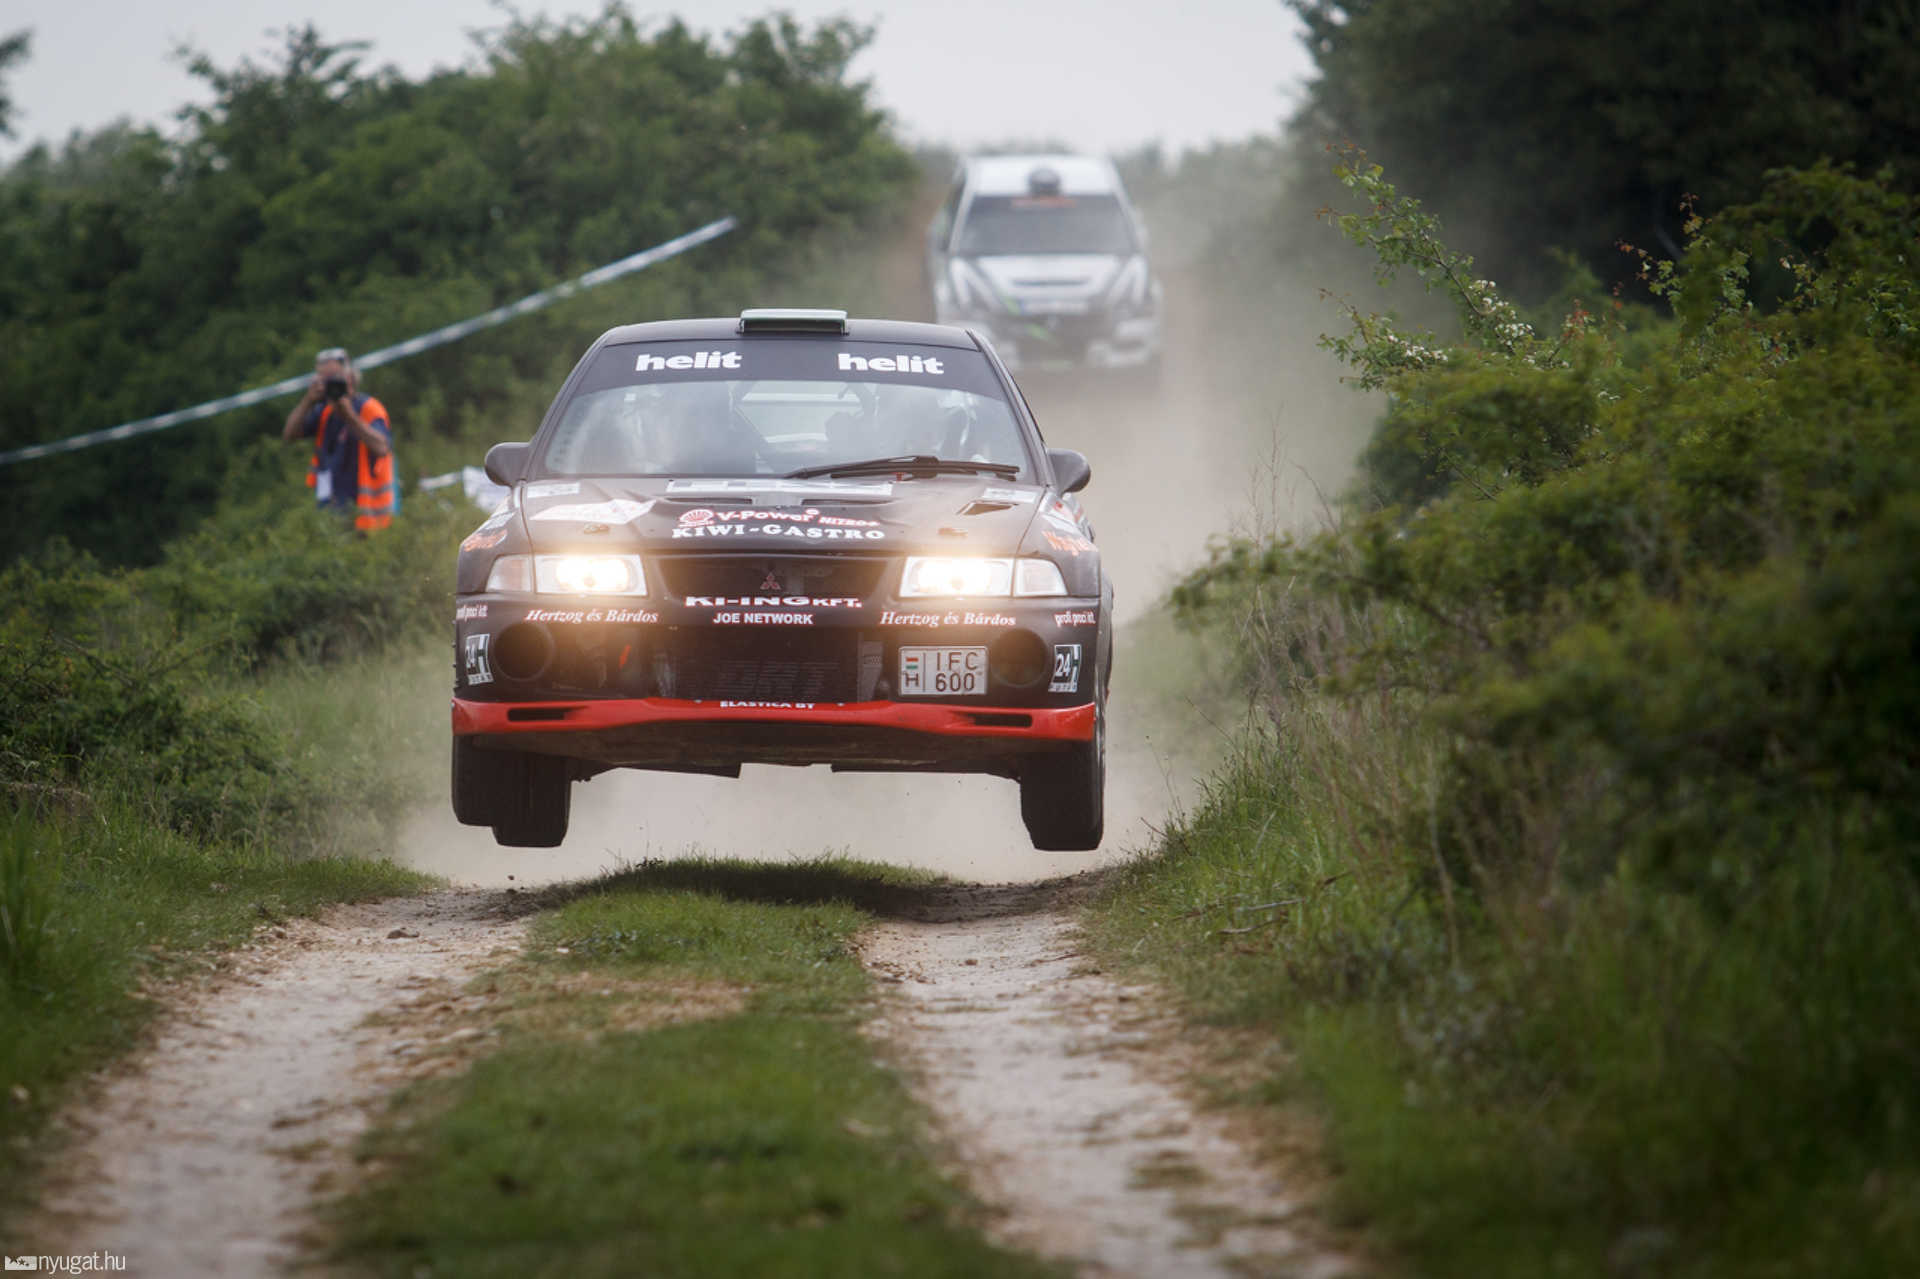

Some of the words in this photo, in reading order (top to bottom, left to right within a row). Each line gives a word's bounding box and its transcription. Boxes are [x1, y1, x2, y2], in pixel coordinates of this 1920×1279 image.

[635, 351, 742, 371] helit
[837, 353, 944, 375] helit
[672, 524, 885, 539] KIWI-GASTRO
[525, 609, 583, 623] Hertzog
[586, 609, 602, 622] és
[605, 609, 659, 623] Bárdos
[713, 613, 741, 624] JOE
[744, 613, 814, 625] NETWORK
[880, 611, 939, 626] Hertzog
[944, 612, 959, 625] és
[963, 612, 1016, 626] Bárdos
[935, 672, 975, 692] 600
